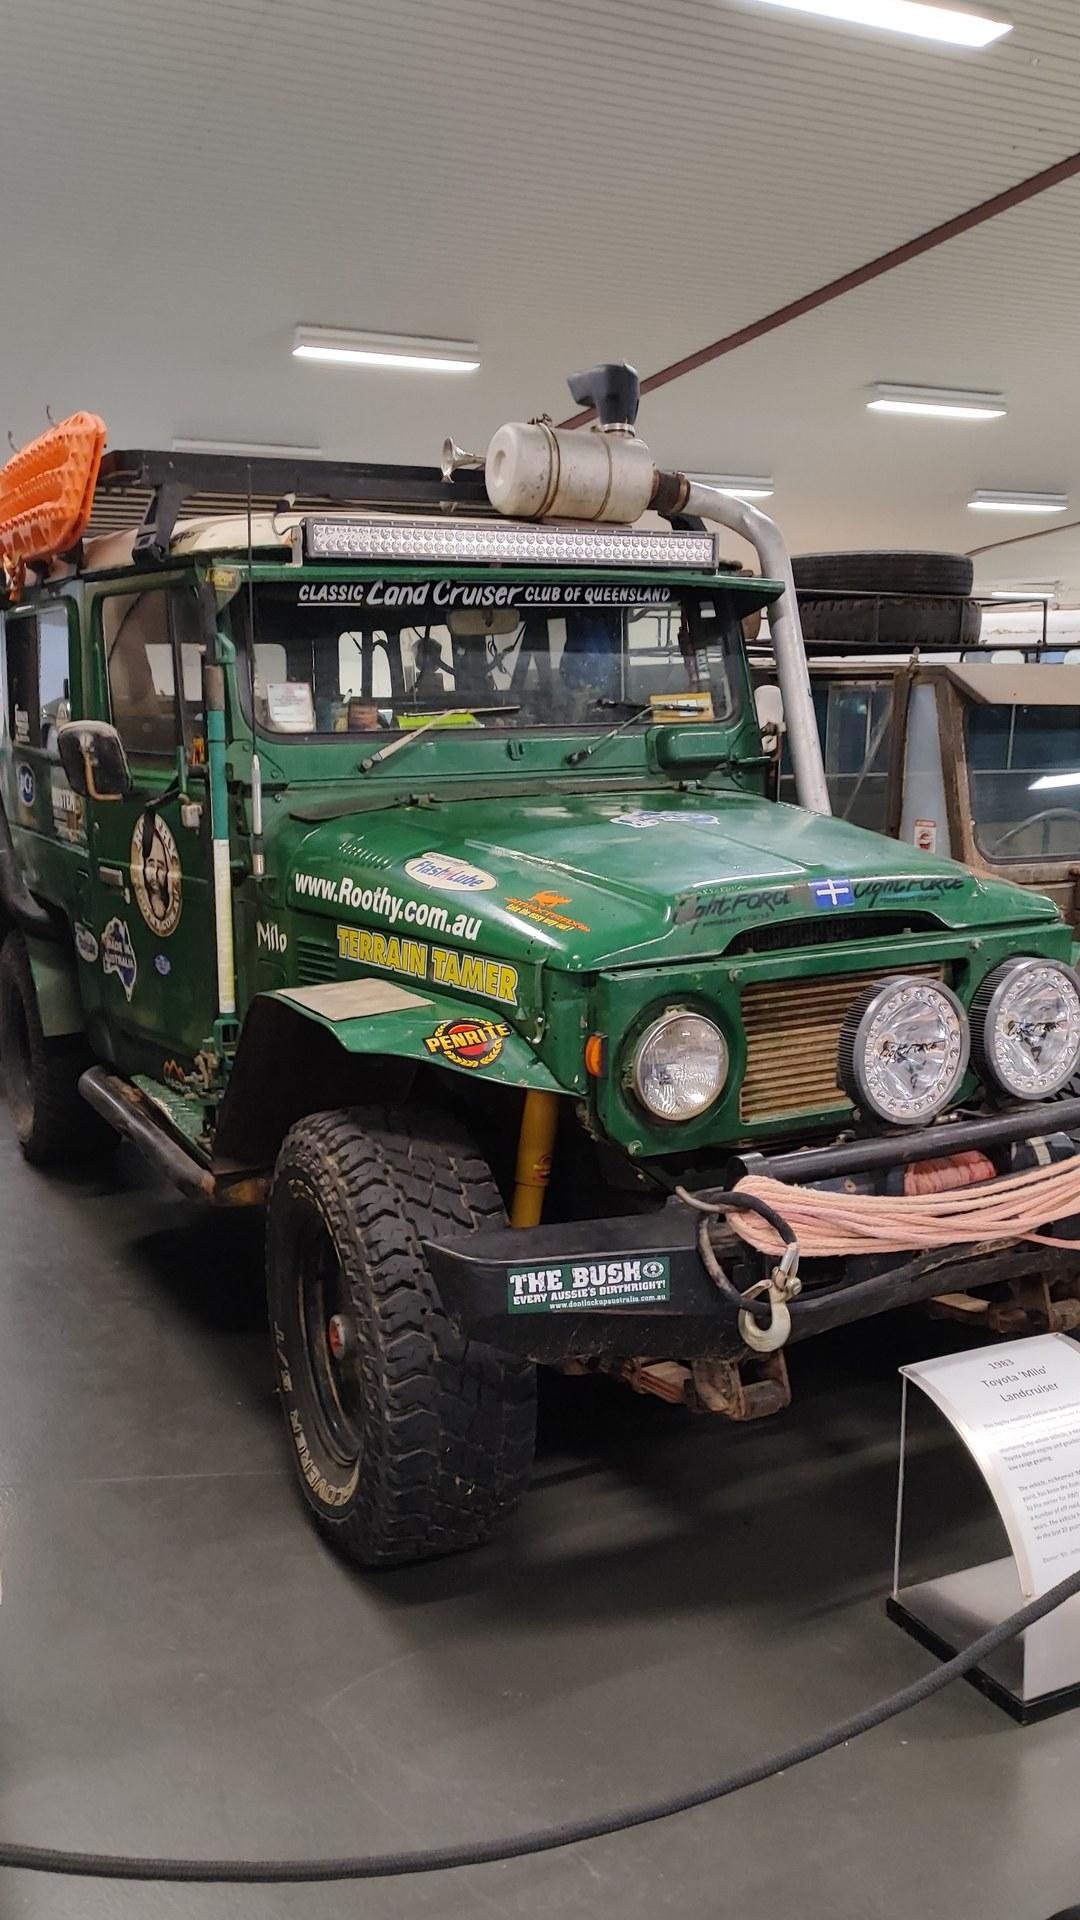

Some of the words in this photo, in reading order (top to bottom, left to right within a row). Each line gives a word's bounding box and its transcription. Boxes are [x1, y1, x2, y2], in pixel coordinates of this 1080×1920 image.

[298, 584, 364, 601] CLASSIC
[366, 580, 430, 606] Land
[433, 580, 524, 606] Cruiser
[525, 586, 561, 602] CLUB
[564, 586, 581, 602] OF
[584, 586, 671, 605] QUEENSLAND
[295, 872, 482, 941] www.Roothy.com.au
[256, 920, 287, 953] Milo
[337, 925, 428, 979] TERRAIN
[432, 947, 519, 1006] TAMER
[424, 1023, 511, 1054] PENRITE
[509, 1269, 563, 1295] THE
[572, 1261, 641, 1289] BUSH
[513, 1293, 547, 1305] EVERY
[550, 1287, 597, 1301] AUSSIE'S
[988, 1359, 1015, 1369] 1983
[980, 1374, 1020, 1388] Toyota
[1000, 1383, 1059, 1402] Landcruiser
